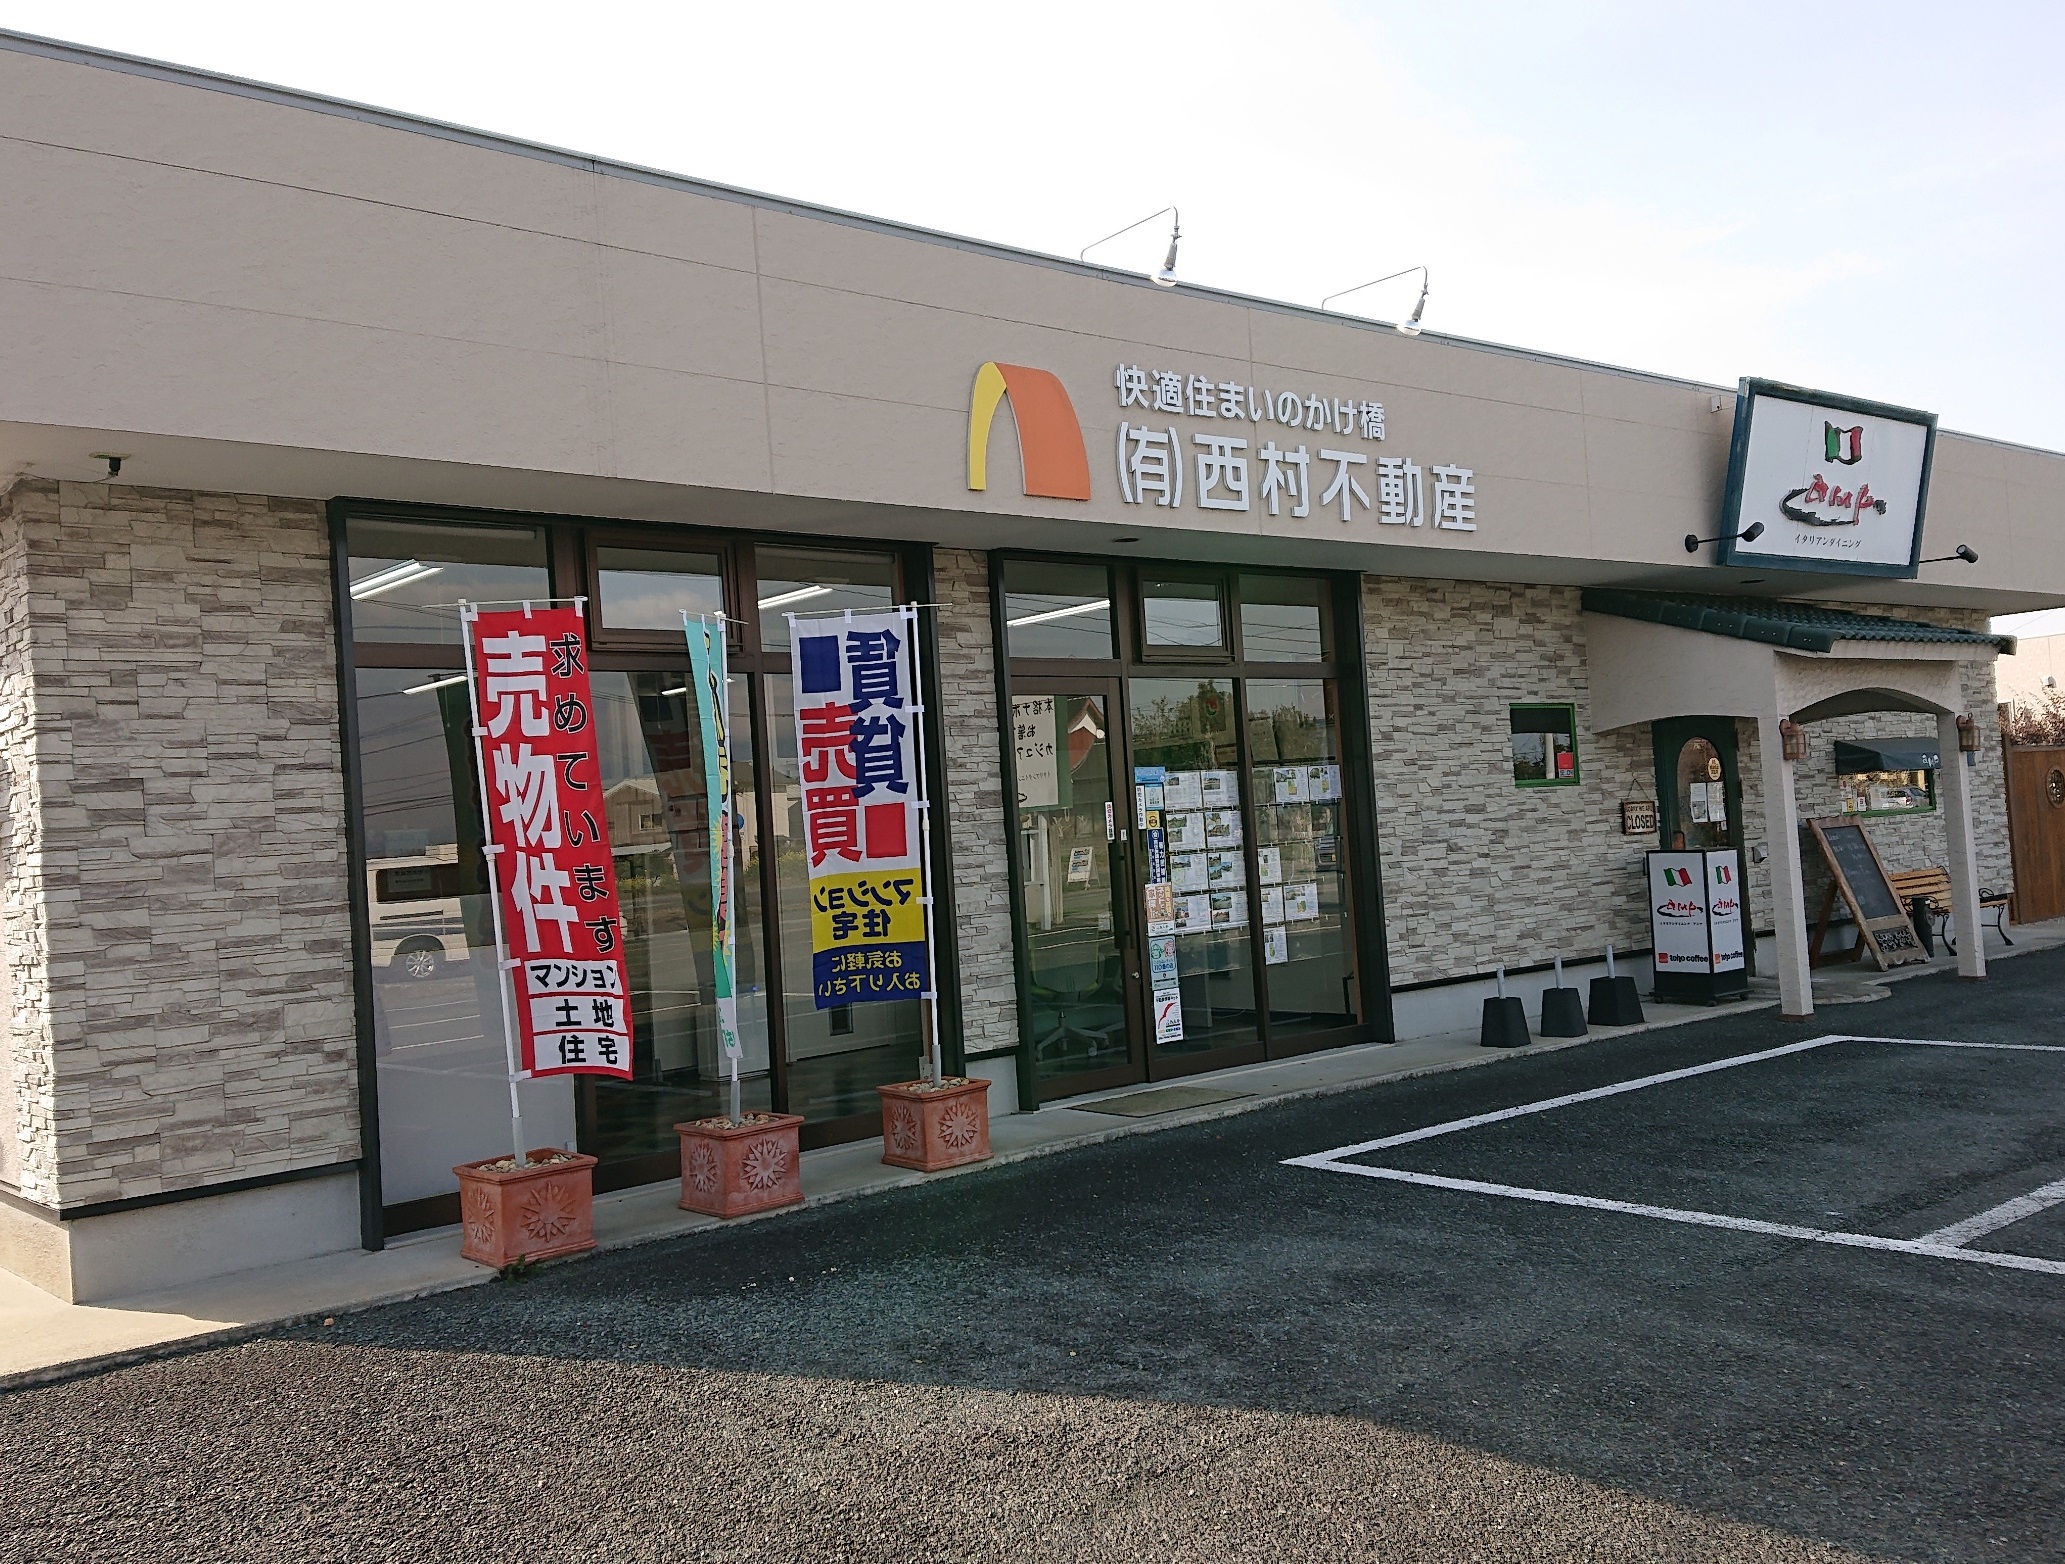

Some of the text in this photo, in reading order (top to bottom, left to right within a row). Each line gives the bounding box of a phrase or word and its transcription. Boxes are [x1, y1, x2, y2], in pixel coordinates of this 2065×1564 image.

[1115, 363, 1386, 441] 快適住まいのかけ橋
[1794, 533, 1863, 549] イタリアンダイニング
[481, 630, 580, 954] 売物件
[548, 632, 618, 955] 求めています
[1626, 814, 1655, 830] CLOSED
[1669, 953, 1685, 963] toho
[1686, 954, 1709, 963] coffee
[529, 963, 617, 990] マンション
[553, 997, 615, 1028] 土地
[558, 1033, 620, 1066] 住宅
